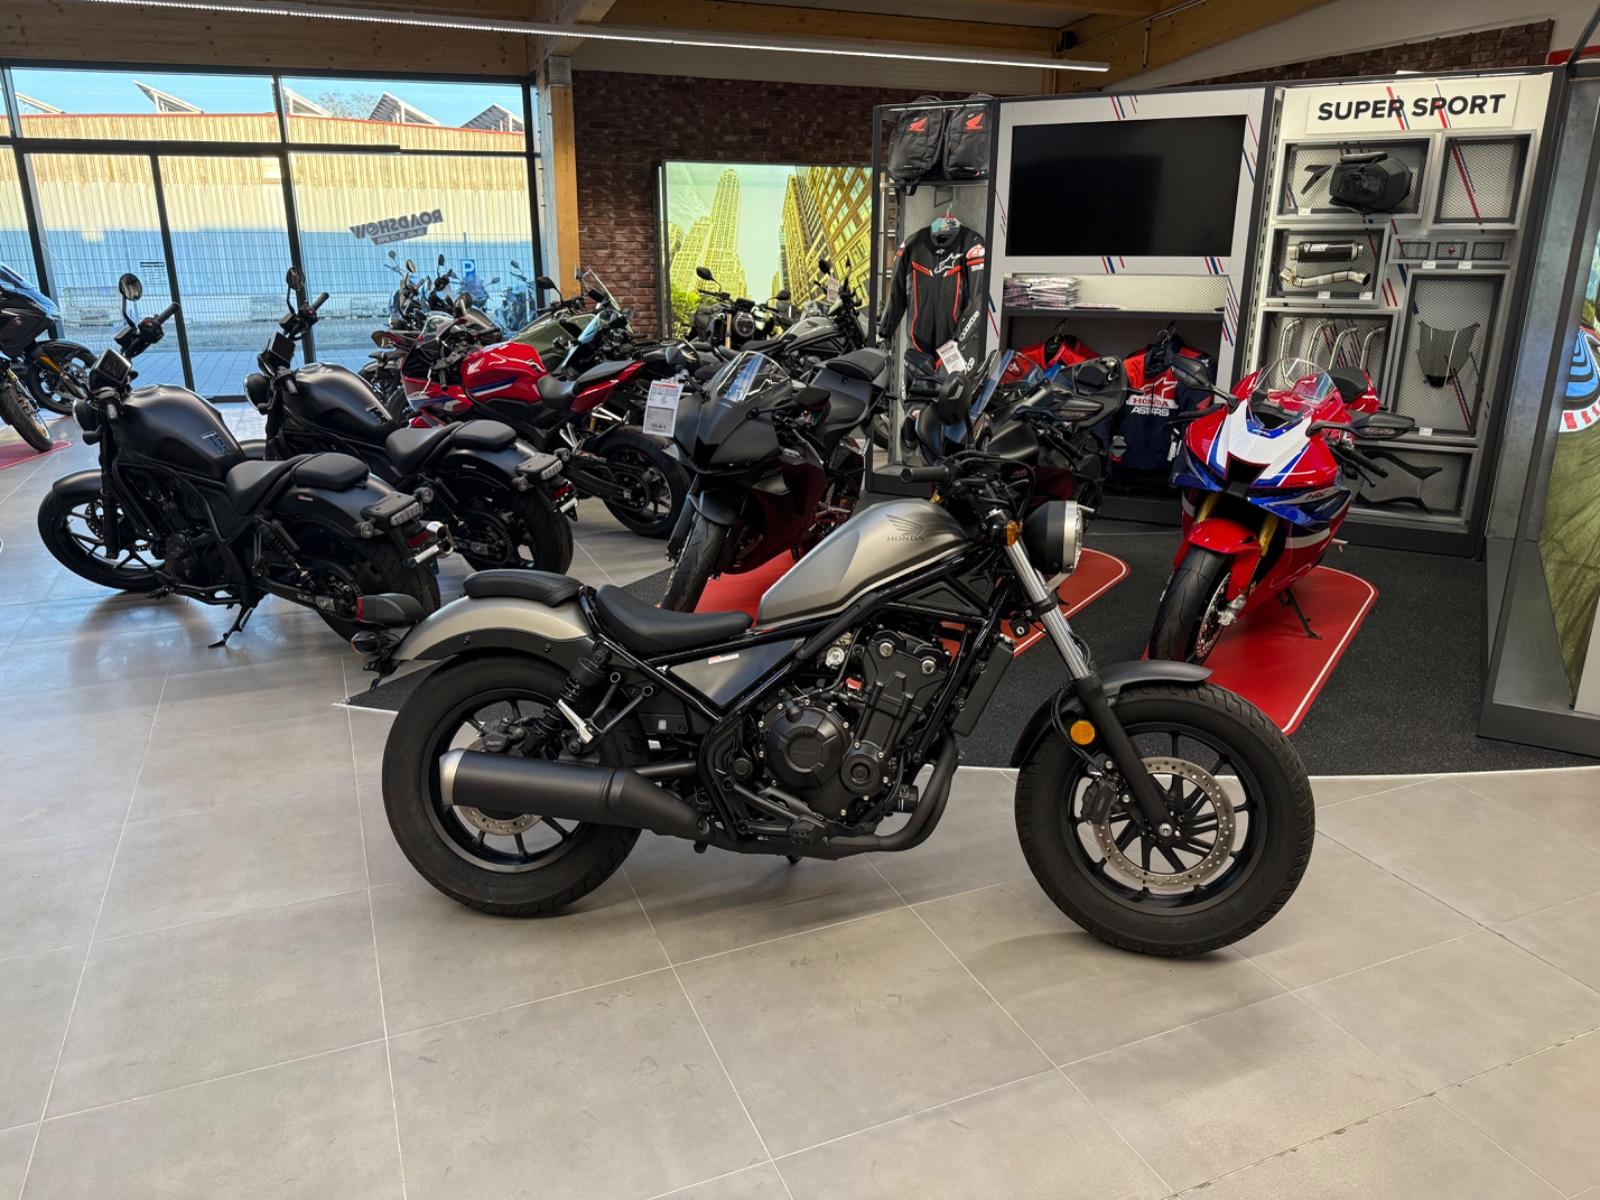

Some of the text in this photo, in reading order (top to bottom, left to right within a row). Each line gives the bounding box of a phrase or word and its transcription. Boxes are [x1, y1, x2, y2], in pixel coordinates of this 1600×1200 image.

[1318, 94, 1506, 121] SUPER SPORT
[462, 260, 475, 278] P
[1132, 397, 1169, 407] HONDA
[886, 535, 924, 543] HONDA
